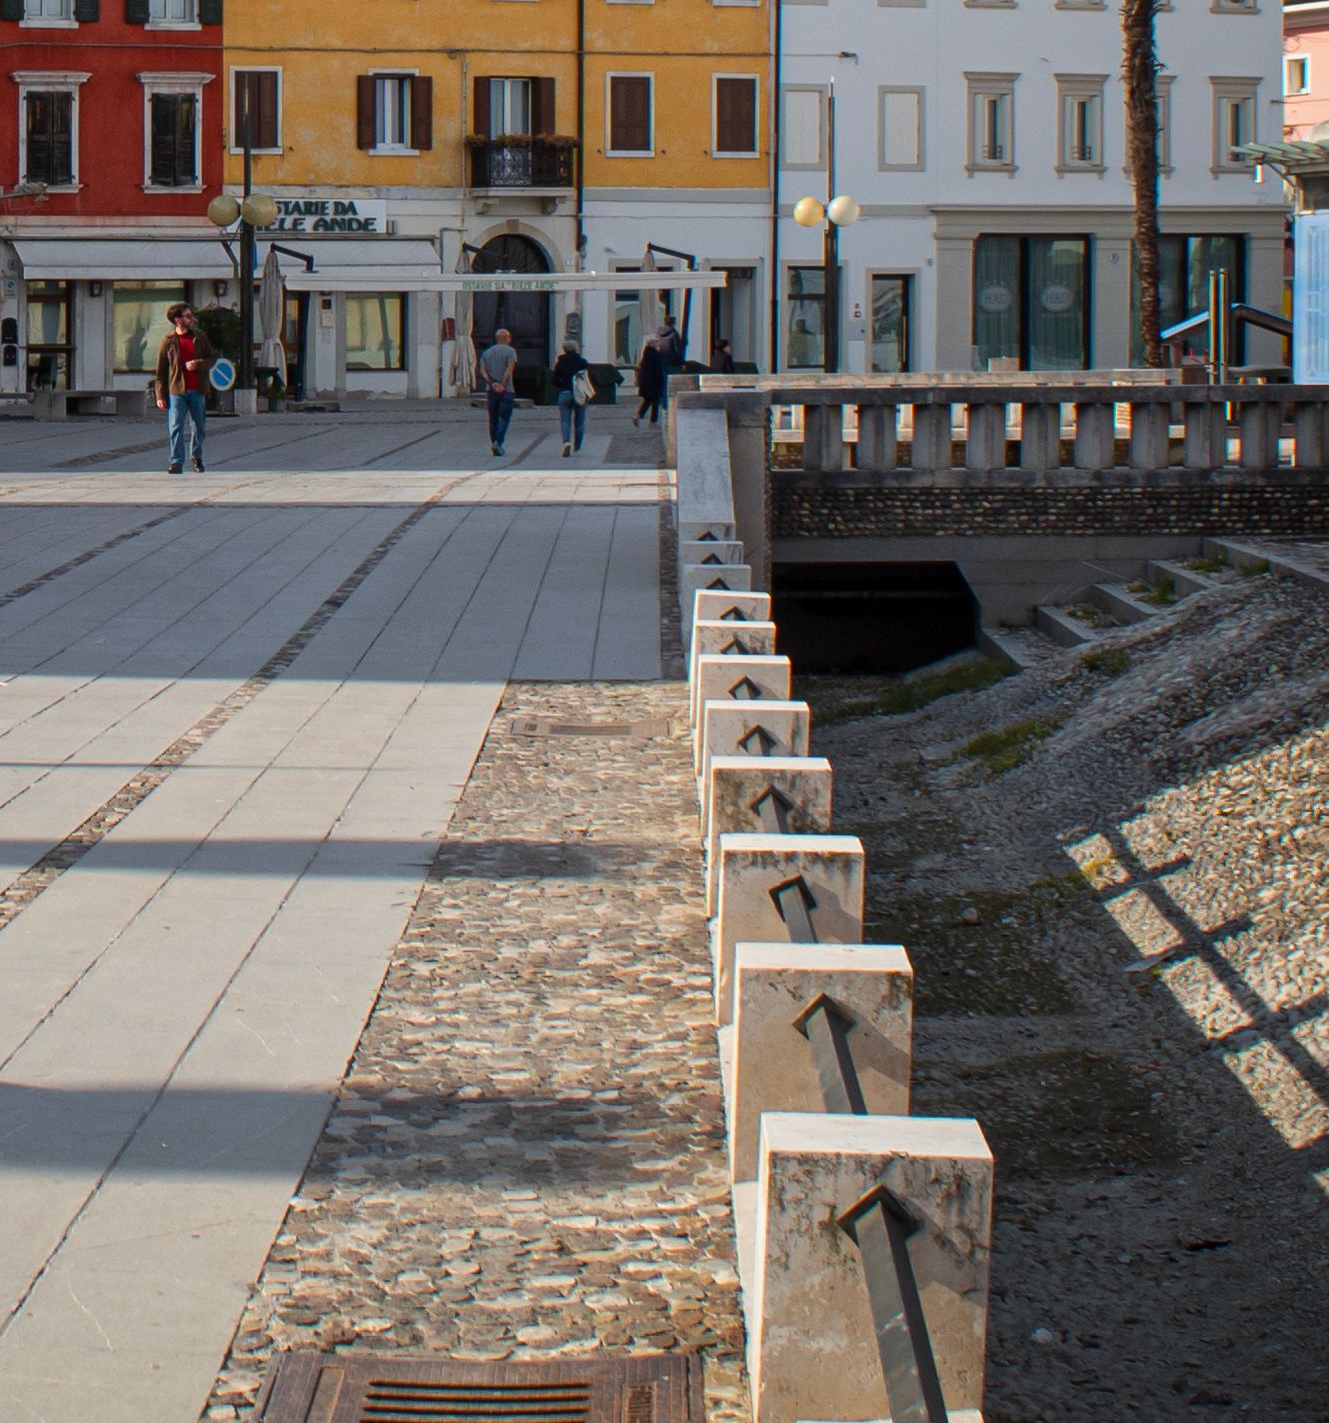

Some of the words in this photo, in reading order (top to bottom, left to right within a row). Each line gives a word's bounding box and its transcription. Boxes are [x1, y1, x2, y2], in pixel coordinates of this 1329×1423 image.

[275, 200, 330, 216] STARIE
[334, 200, 358, 216] DA
[312, 217, 377, 232] ANDE
